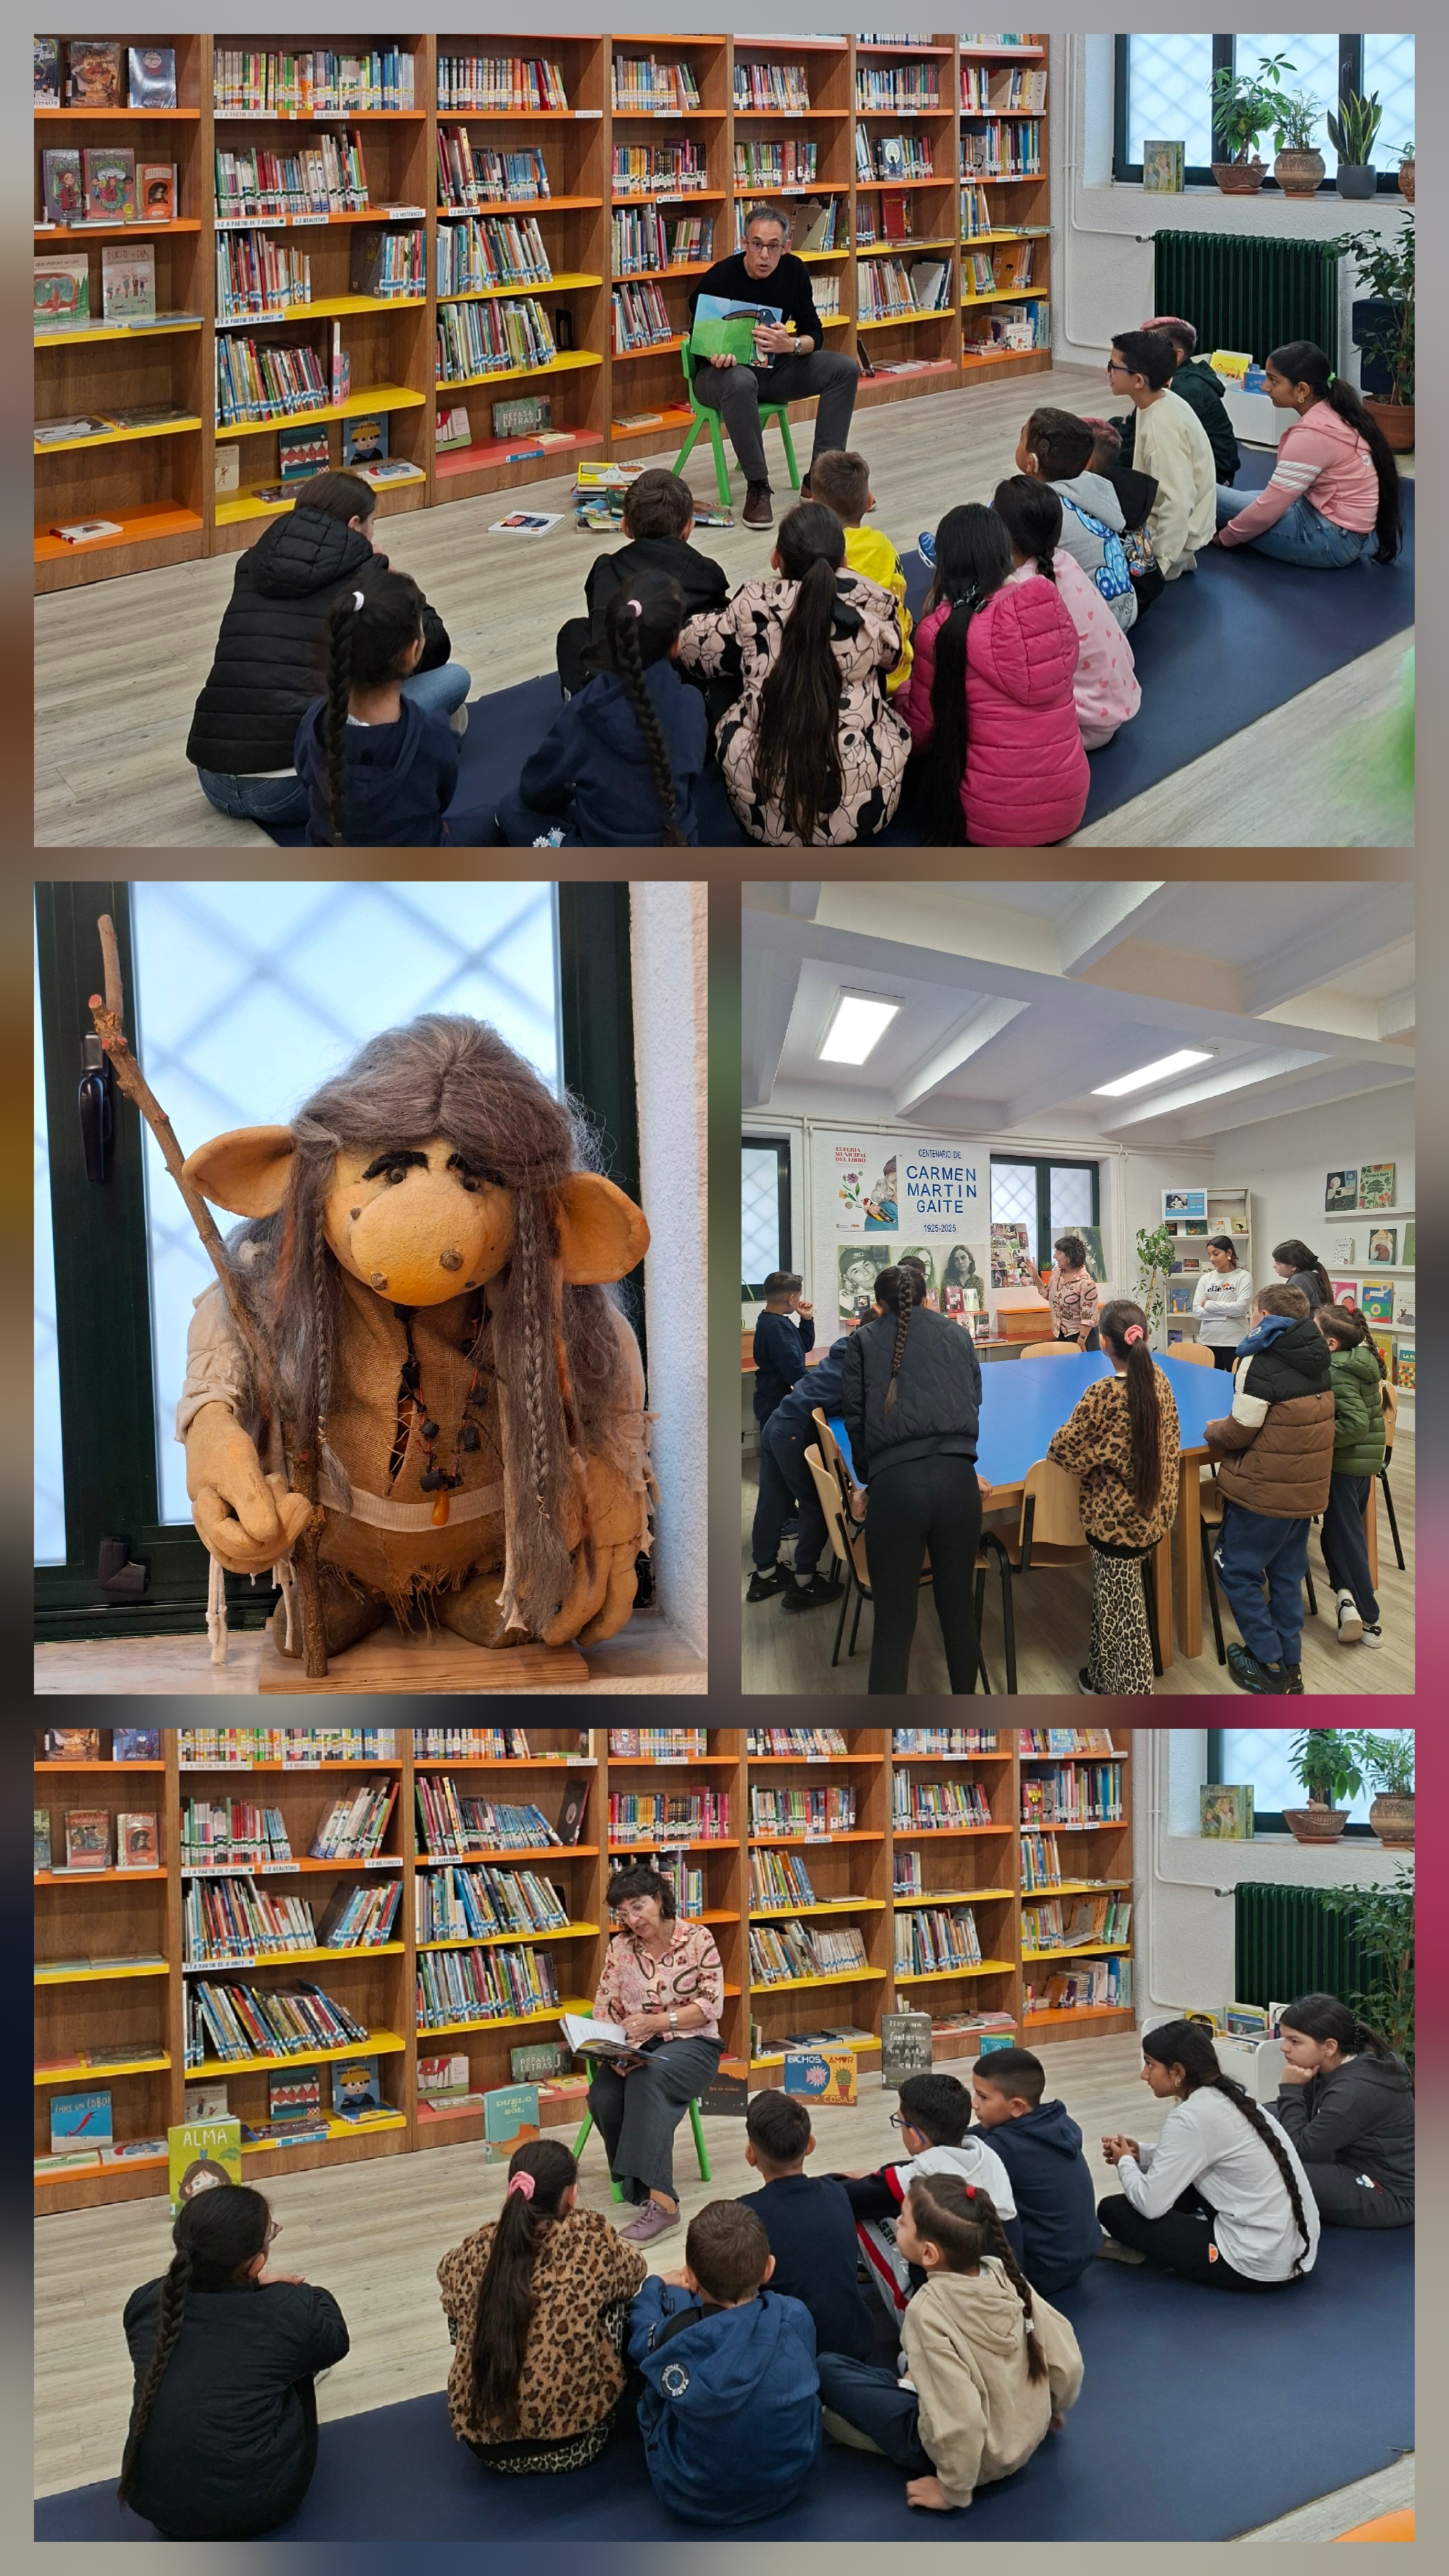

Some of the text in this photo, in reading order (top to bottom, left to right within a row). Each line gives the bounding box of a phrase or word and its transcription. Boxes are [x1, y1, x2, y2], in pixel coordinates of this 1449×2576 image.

[503, 411, 533, 420] REPASA
[503, 419, 535, 429] LETRAS
[918, 1149, 951, 1158] CENTENARIO
[906, 1165, 976, 1181] CARMEN
[907, 1183, 977, 1197] MARTIN
[916, 1199, 963, 1213] GAITE
[924, 1224, 957, 1232] 1925-2025
[521, 2055, 552, 2065] REPASA
[521, 2062, 552, 2072] LETRAS
[824, 2096, 855, 2104] COSAS
[183, 2129, 227, 2147] ALMA
